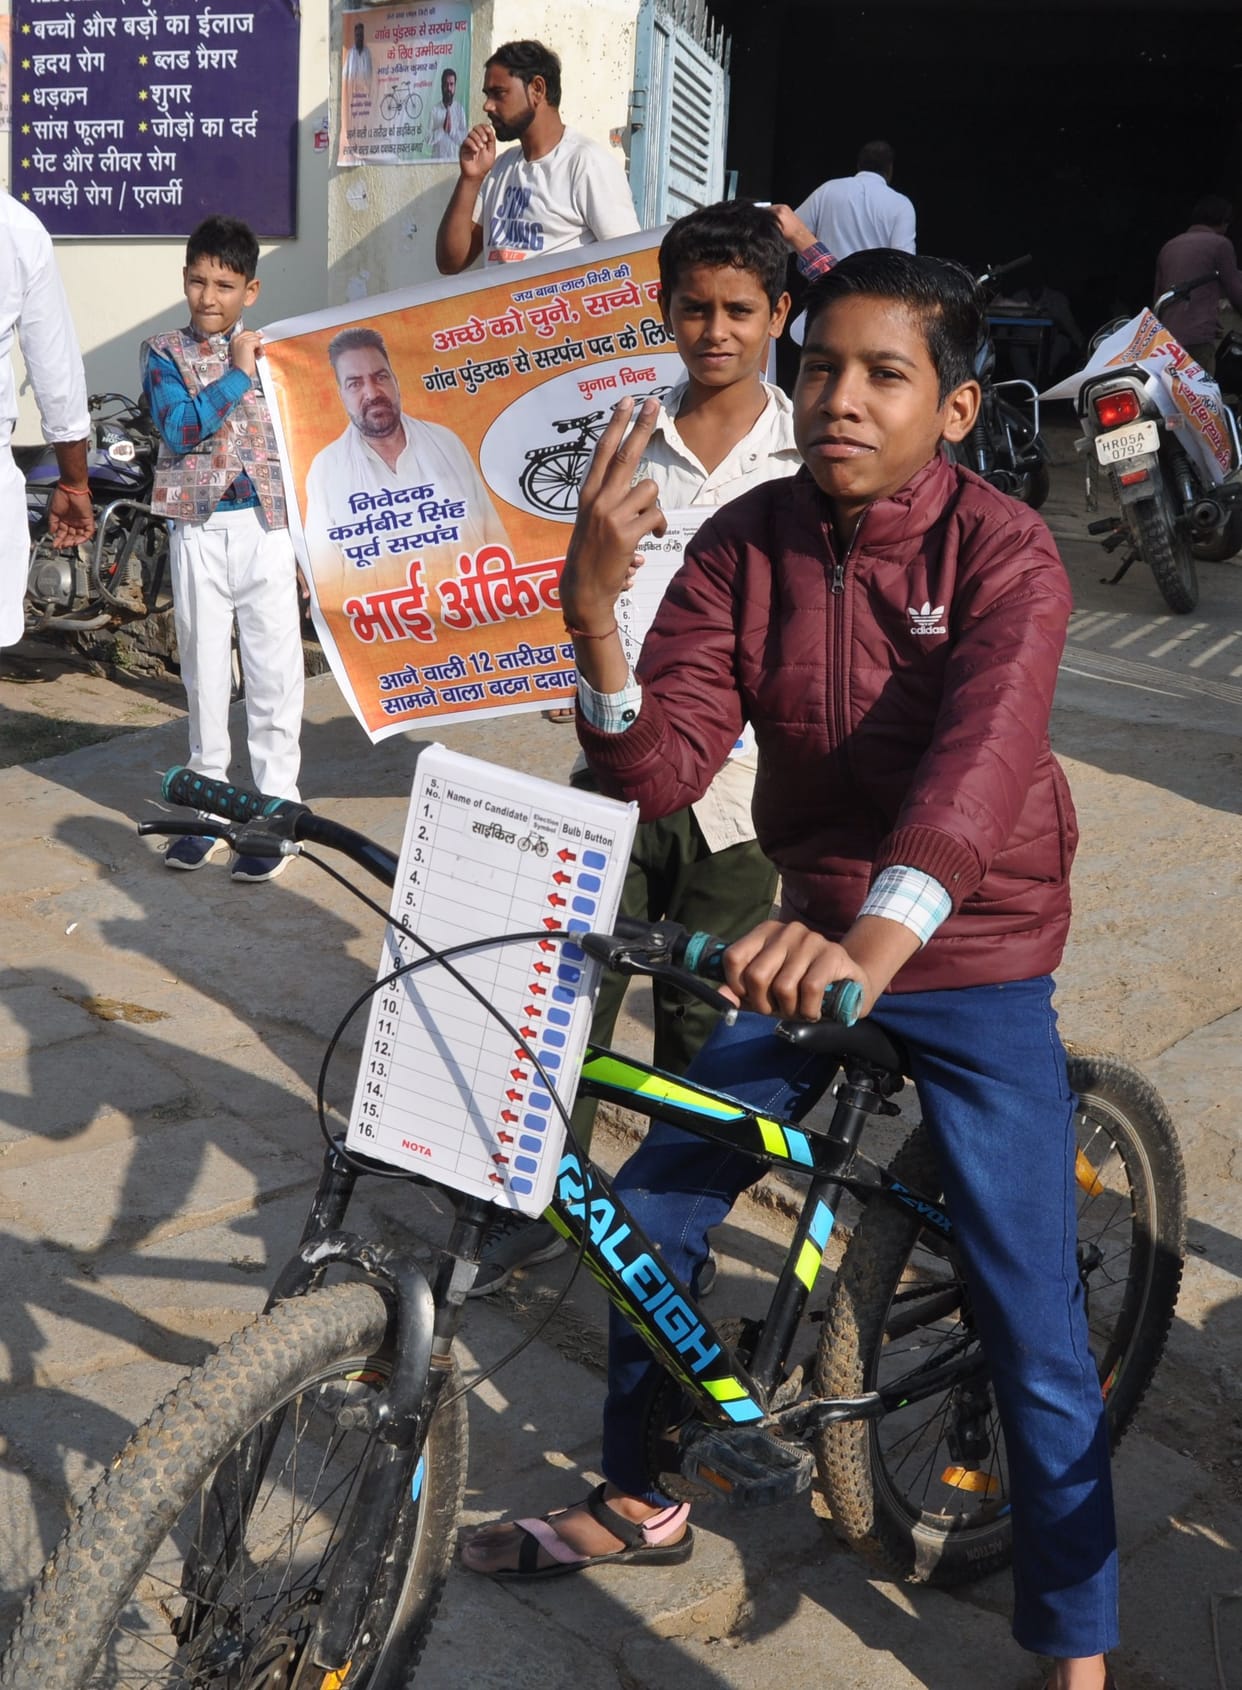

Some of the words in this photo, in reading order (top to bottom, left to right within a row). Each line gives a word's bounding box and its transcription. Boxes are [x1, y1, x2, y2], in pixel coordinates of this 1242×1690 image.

[32, 13, 76, 40] बच्चों
[83, 11, 117, 38] और
[122, 9, 158, 40] बड़ों
[164, 14, 190, 35] का
[196, 7, 254, 38] ईलाज
[419, 22, 426, 36] से
[455, 20, 467, 31] पद
[32, 54, 71, 76] हृदय
[76, 46, 105, 72] रोग
[153, 51, 190, 70] ब्लड
[196, 43, 238, 69] प्रैशर
[387, 46, 396, 60] के
[33, 87, 88, 111] धड़कन
[150, 84, 192, 112] शुगर
[32, 114, 68, 140] सांस
[74, 119, 124, 146] फूलना
[151, 111, 195, 142] जोड़ों
[200, 118, 224, 137] का
[229, 110, 259, 138] दर्द
[32, 147, 57, 173] पेट
[63, 146, 94, 172] और
[99, 145, 141, 172] लीवर
[147, 145, 176, 171] रोग
[32, 179, 78, 210] चमड़ी
[84, 180, 113, 206] रोग
[118, 181, 127, 212] /
[133, 178, 183, 209] एलर्जी
[513, 290, 533, 302] जय
[536, 285, 558, 298] बाबा
[561, 278, 585, 291] लाल
[587, 270, 611, 285] गिरी
[614, 264, 629, 279] की
[434, 318, 485, 351] अच्छे
[490, 308, 524, 337] को
[584, 281, 641, 316] सच्चे
[423, 366, 457, 392] गांव
[460, 354, 510, 392] पुंडरक
[515, 348, 531, 372] से
[534, 335, 585, 367] सरपंच
[588, 333, 614, 355] पद
[617, 325, 638, 349] के
[578, 376, 616, 398] चुनाव
[1102, 432, 1145, 452] HR05A
[1112, 443, 1144, 460] 0792
[349, 483, 435, 514] निवेदक
[417, 498, 466, 522] सिंह
[345, 541, 380, 568] पूर्व
[386, 525, 459, 552] सरपंच
[346, 560, 435, 642] भाई
[379, 665, 419, 691] आने
[422, 656, 468, 682] वाली
[470, 652, 493, 673] 12
[495, 643, 556, 670] तारीख
[381, 686, 438, 714] सामने
[441, 682, 483, 704] वाला
[488, 675, 529, 696] बटन
[425, 786, 441, 800] No.
[423, 804, 433, 819] 1.
[447, 789, 472, 806] Name
[473, 798, 483, 809] of
[485, 801, 529, 823] Candidate
[533, 813, 560, 827] Election
[533, 822, 557, 834] Symbol
[418, 826, 429, 841] 2.
[562, 823, 582, 838] Bulb
[584, 829, 613, 847] Button
[414, 848, 425, 863] 3.
[409, 870, 421, 885] 4.
[405, 892, 416, 907] 5.
[401, 914, 412, 929] 6.
[398, 936, 408, 950] 7.
[389, 979, 400, 993] 9.
[382, 998, 399, 1015] 10.
[378, 1019, 395, 1036] 11.
[374, 1040, 391, 1056] 12.
[370, 1061, 387, 1077] 13.
[366, 1081, 383, 1098] 14.
[362, 1102, 379, 1118] 15.
[358, 1122, 375, 1138] 16.
[402, 1139, 432, 1157] NOTA
